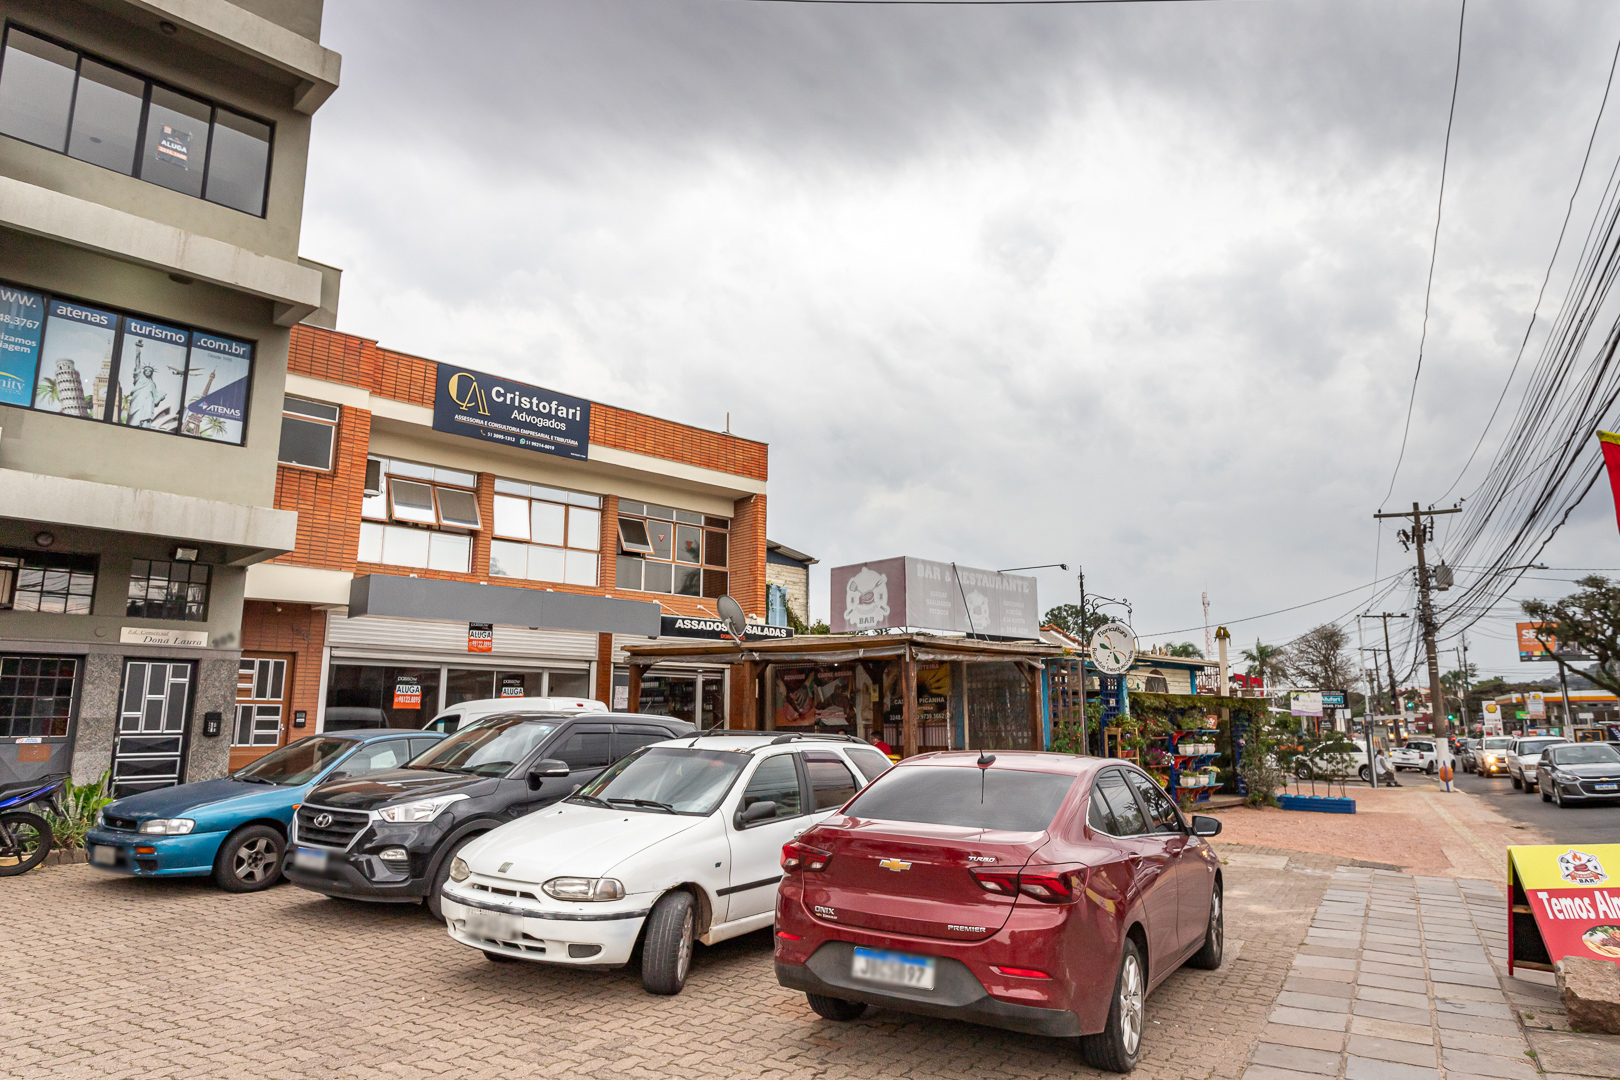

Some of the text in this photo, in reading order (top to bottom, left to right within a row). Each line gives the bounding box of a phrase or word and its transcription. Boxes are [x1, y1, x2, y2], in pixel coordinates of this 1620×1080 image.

[161, 139, 187, 153] ALUGA
[56, 303, 247, 355] atenas turismo .com.br
[491, 386, 581, 421] Cristofari
[205, 404, 241, 417] ATENAS
[511, 409, 566, 431] Advogados
[454, 414, 484, 426] ASSESSORIA
[488, 421, 520, 433] CONSULTORIA
[520, 428, 550, 440] EMPRESARIAL
[916, 563, 1029, 593] BAR & RESTAURANTE
[859, 616, 875, 625] BAR
[470, 630, 492, 639] ALUGA
[675, 619, 787, 638] ASSADOS SALADAS
[1097, 626, 1128, 638] Floricultura
[143, 635, 170, 644] Dona
[173, 637, 202, 646] Laura
[817, 671, 834, 679] CARNE
[397, 685, 420, 694] ALUGA
[503, 687, 523, 695] ALUGA
[814, 905, 835, 915] ONIX
[1537, 891, 1597, 920] Temos
[947, 924, 986, 933] PREMIER
